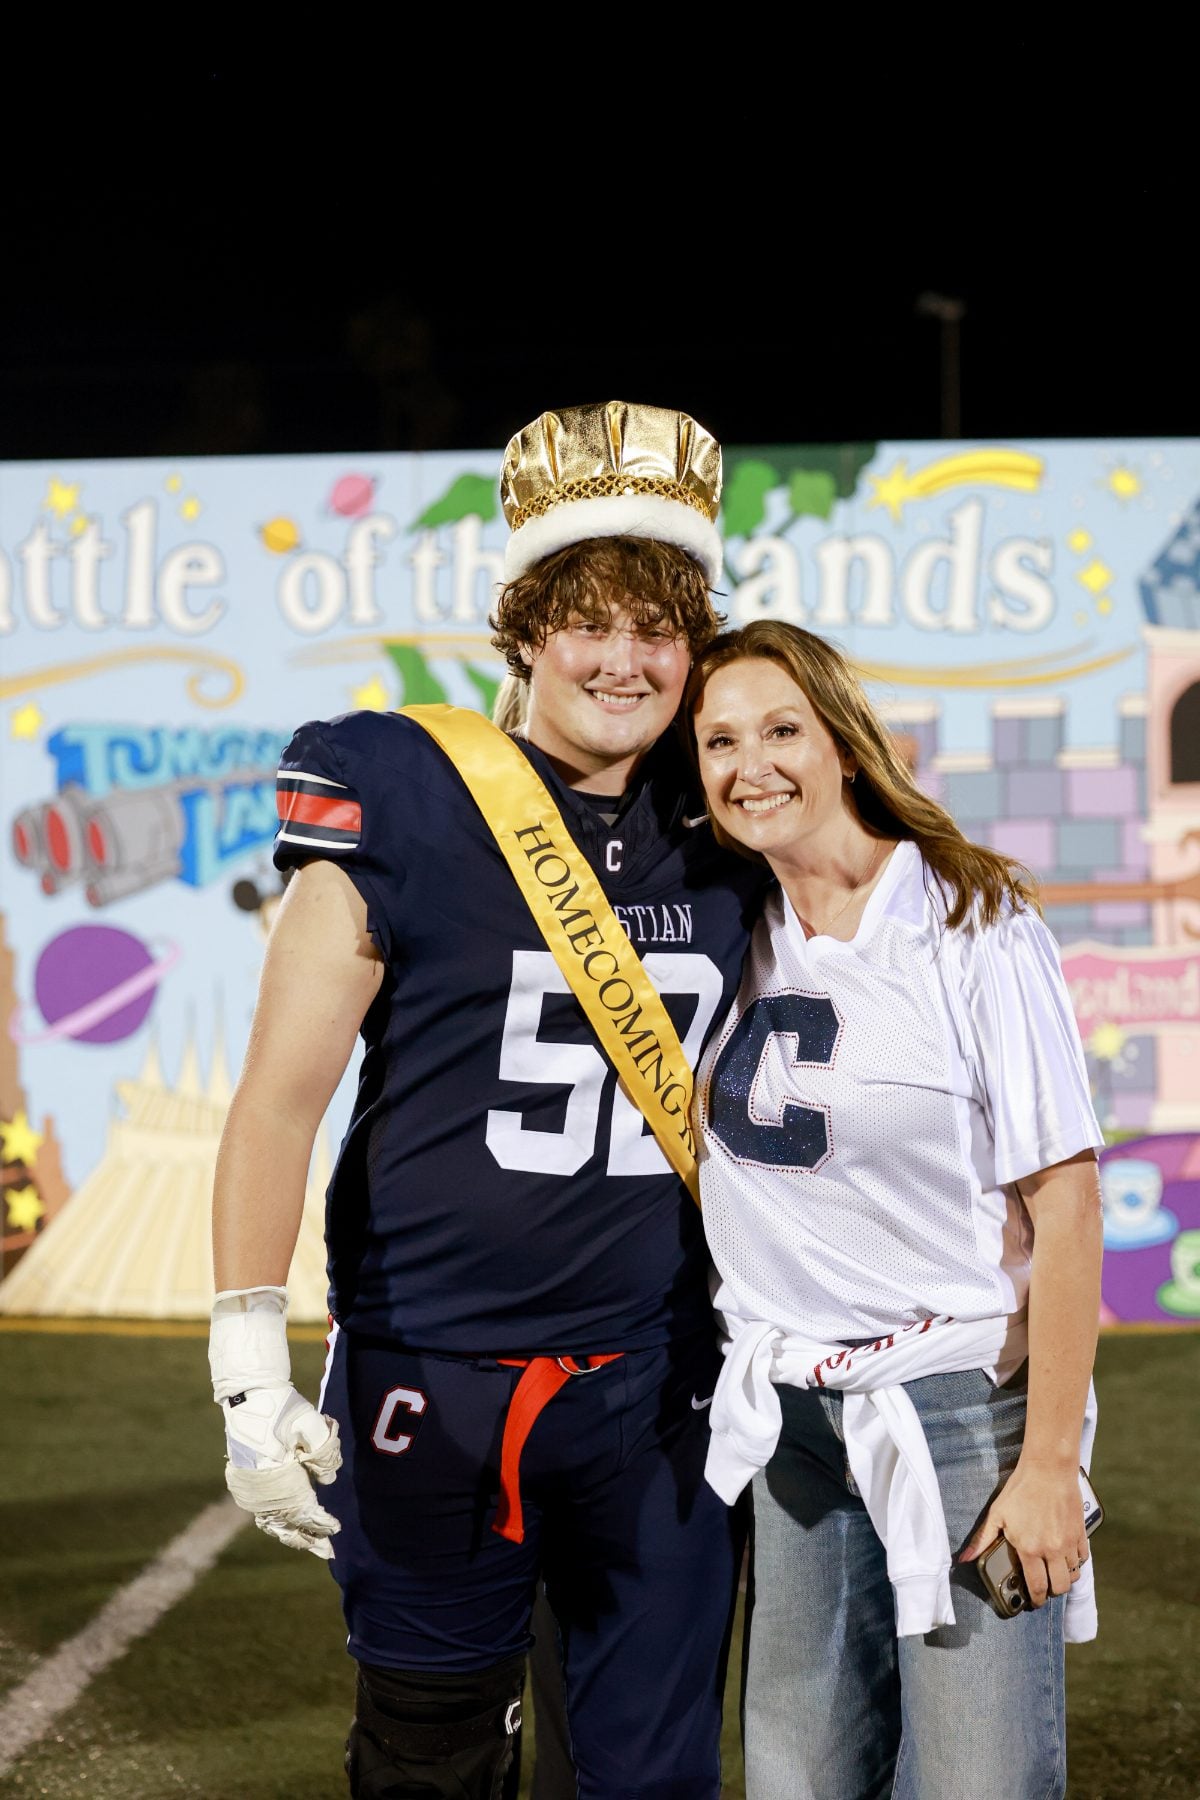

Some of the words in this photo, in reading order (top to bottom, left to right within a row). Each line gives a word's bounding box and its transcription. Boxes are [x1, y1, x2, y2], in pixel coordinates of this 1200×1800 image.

[279, 514, 397, 635] of
[408, 513, 504, 622] th
[731, 495, 1058, 635] ands
[606, 840, 623, 871] C
[609, 904, 692, 943] STIAN
[514, 820, 687, 1116] HOMECOMING
[485, 950, 724, 1177] 52
[701, 986, 845, 1174] C
[370, 1384, 429, 1457] C
